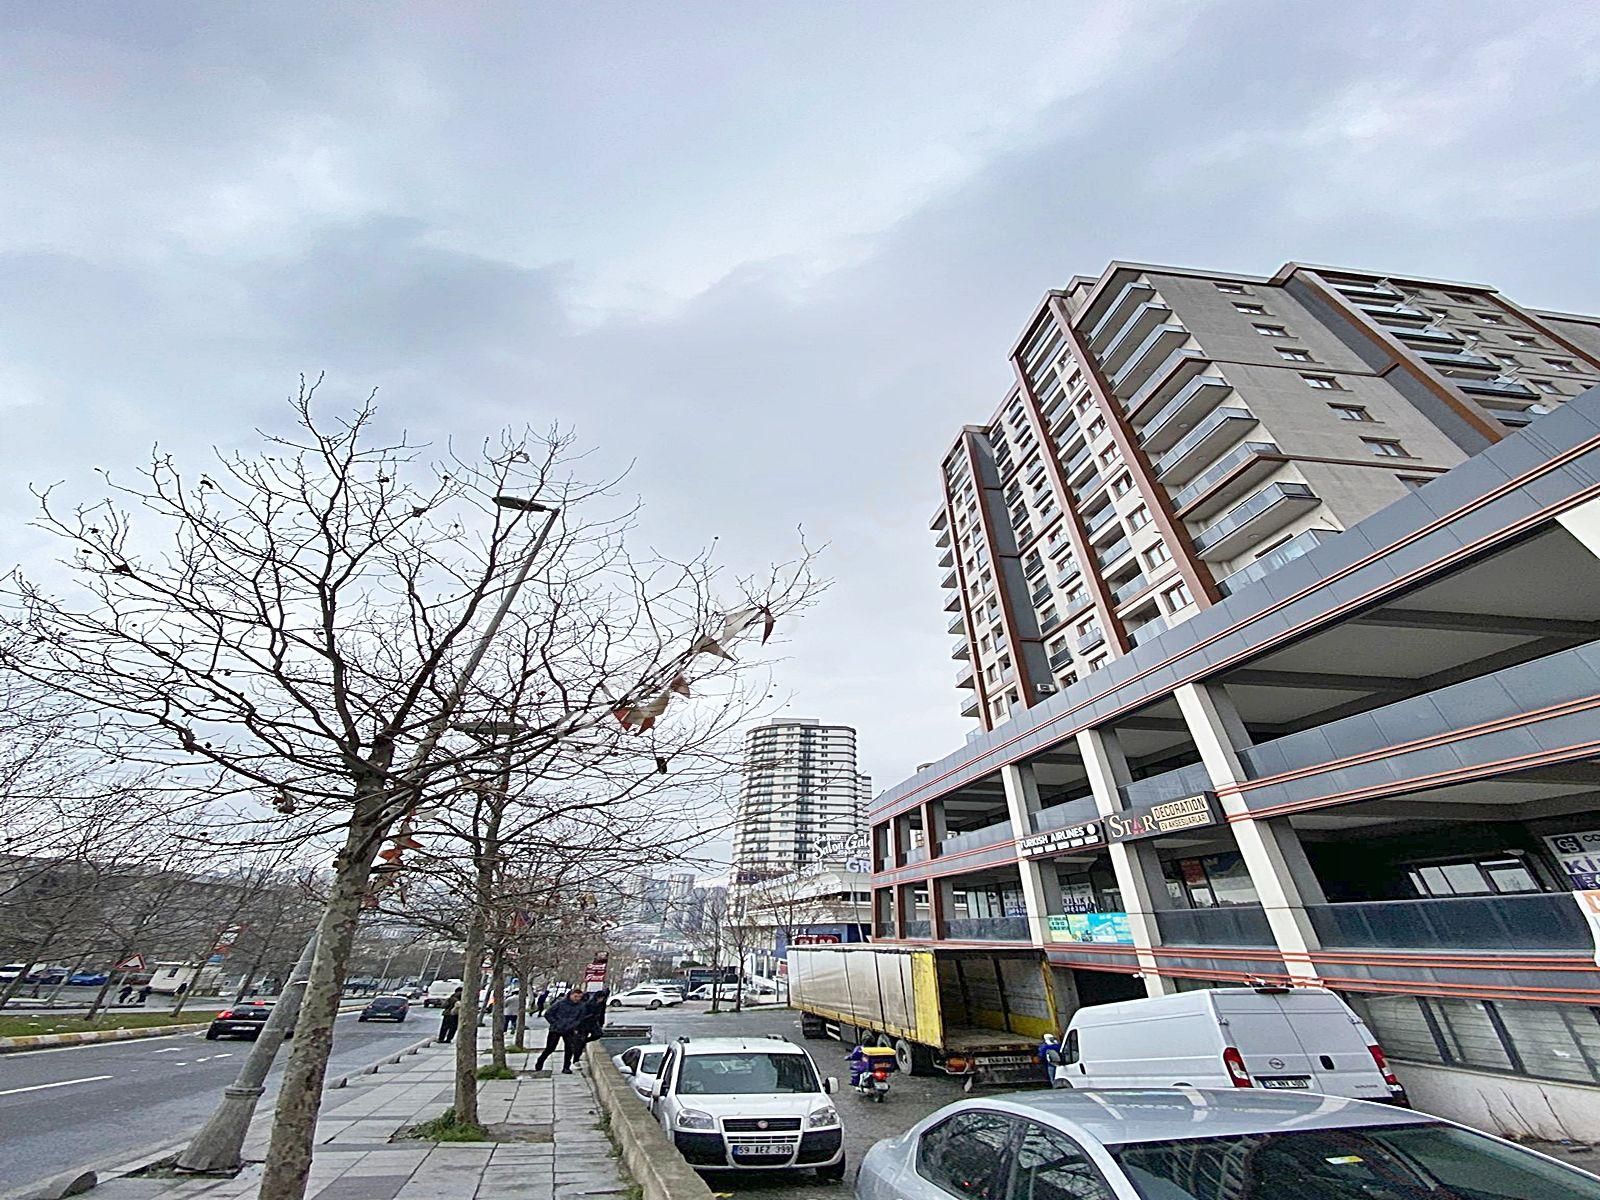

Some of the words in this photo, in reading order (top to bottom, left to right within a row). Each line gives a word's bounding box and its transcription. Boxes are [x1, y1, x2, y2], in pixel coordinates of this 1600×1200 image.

[1153, 797, 1206, 819] DECORATION
[1020, 834, 1049, 848] TURKISH
[1050, 826, 1085, 843] AIRLINES
[813, 840, 844, 859] Salon
